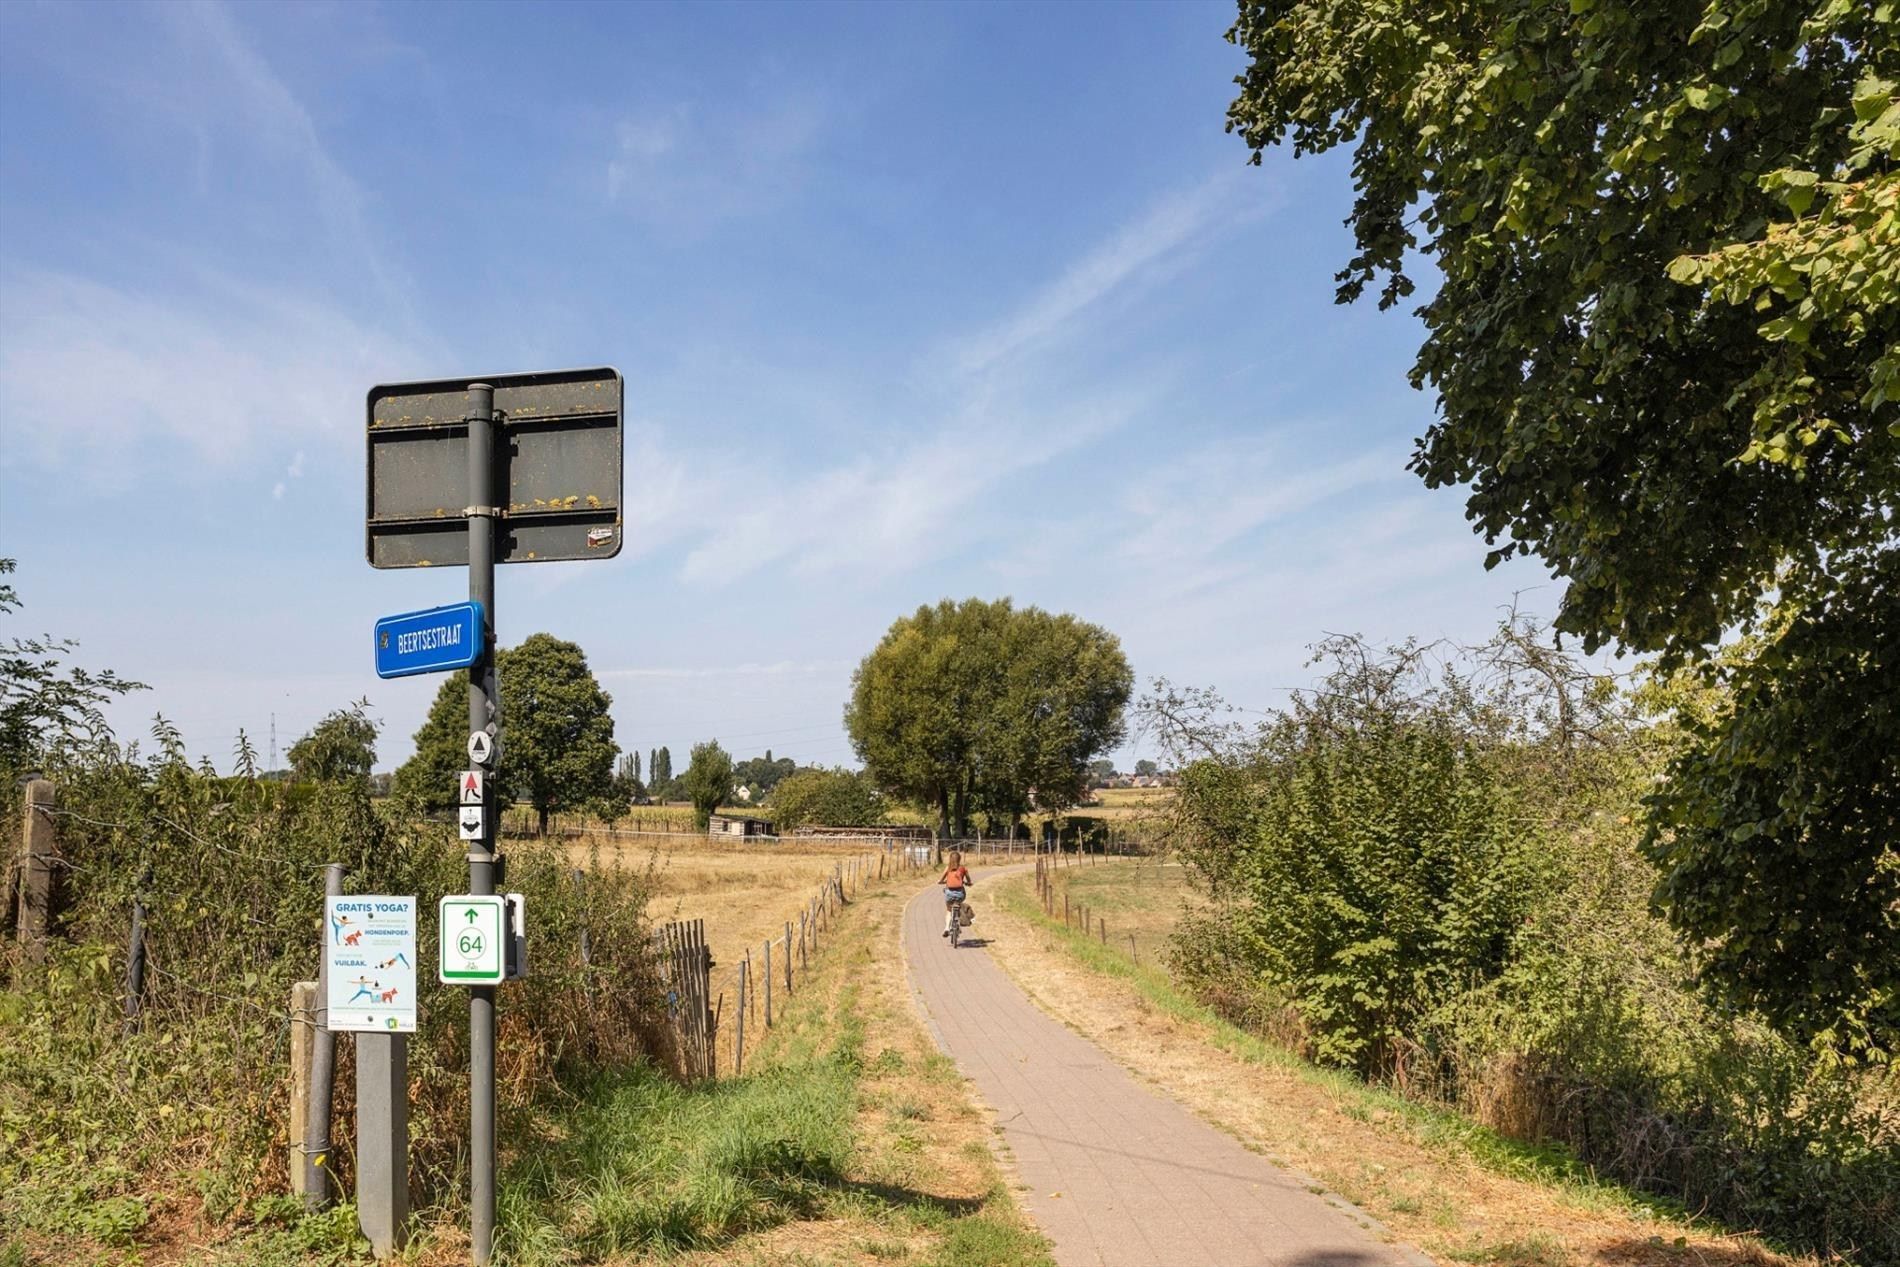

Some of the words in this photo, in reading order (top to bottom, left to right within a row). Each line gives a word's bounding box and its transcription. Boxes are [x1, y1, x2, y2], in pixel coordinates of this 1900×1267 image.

[398, 623, 462, 654] BEERTSESTRAAT
[336, 903, 373, 912] GRATIS
[375, 903, 409, 912] YOGA?
[460, 935, 483, 953] 64
[335, 959, 367, 967] VUILBAK.
